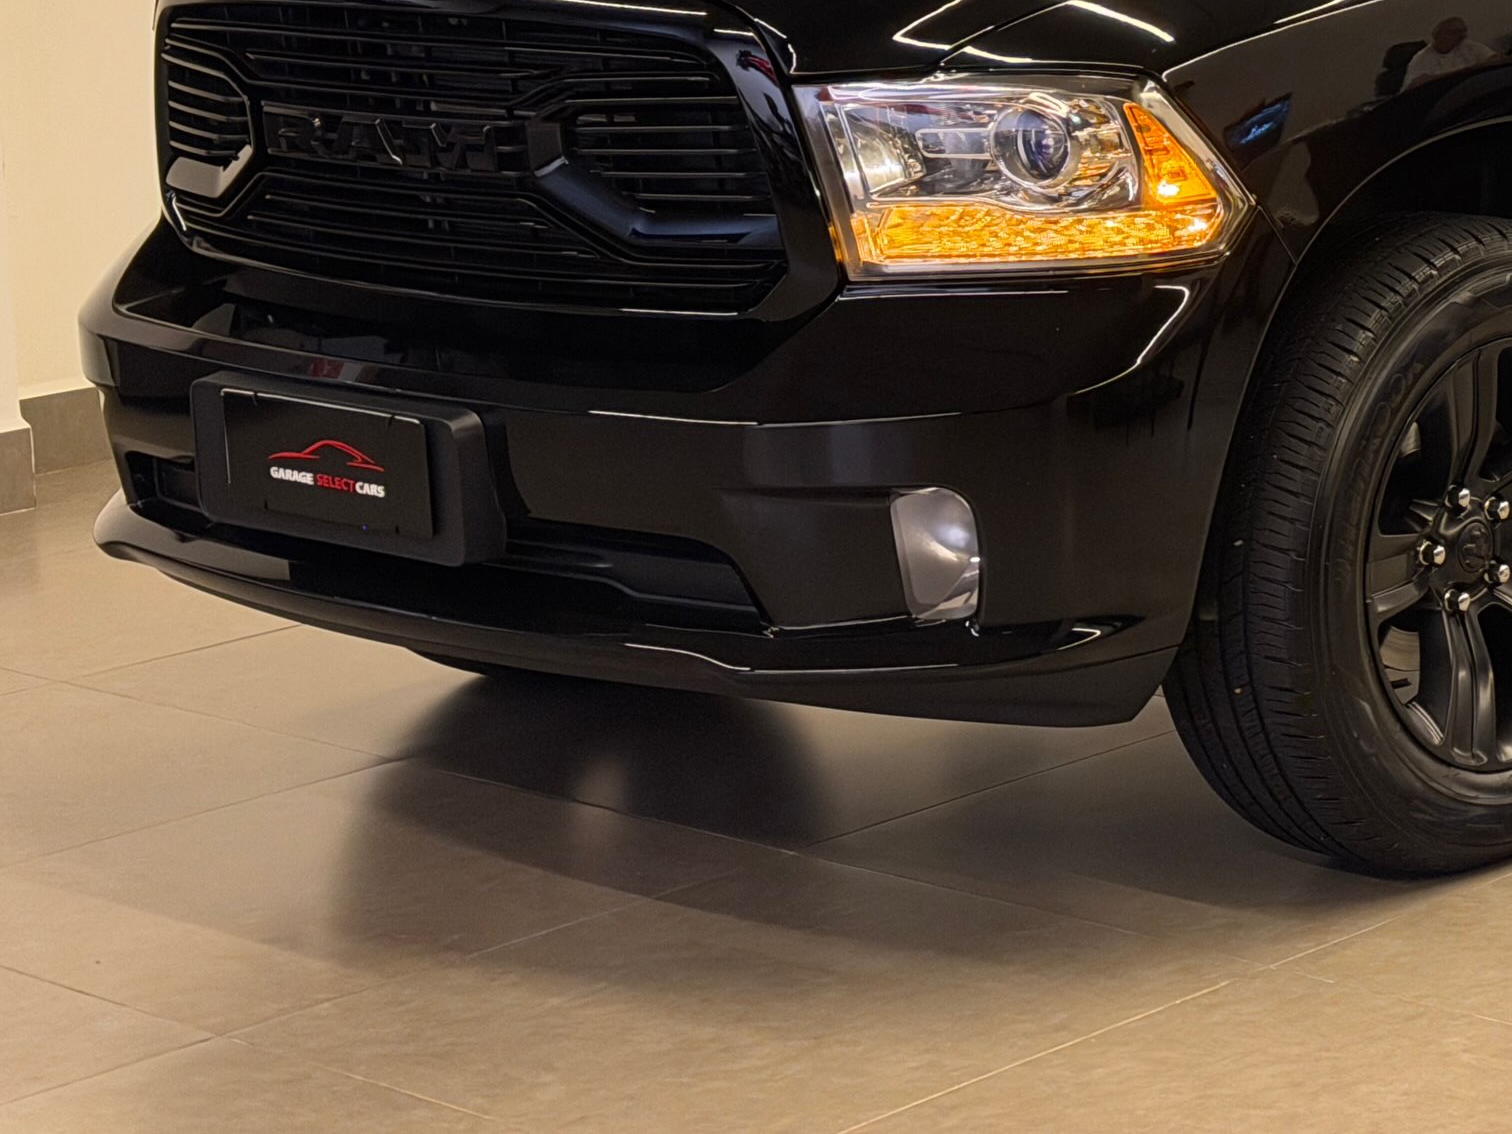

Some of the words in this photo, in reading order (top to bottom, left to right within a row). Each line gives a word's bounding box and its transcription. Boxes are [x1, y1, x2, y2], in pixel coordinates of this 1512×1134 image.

[270, 466, 314, 485] GARAGE
[316, 475, 355, 492] SELECT
[355, 482, 385, 498] CARS
